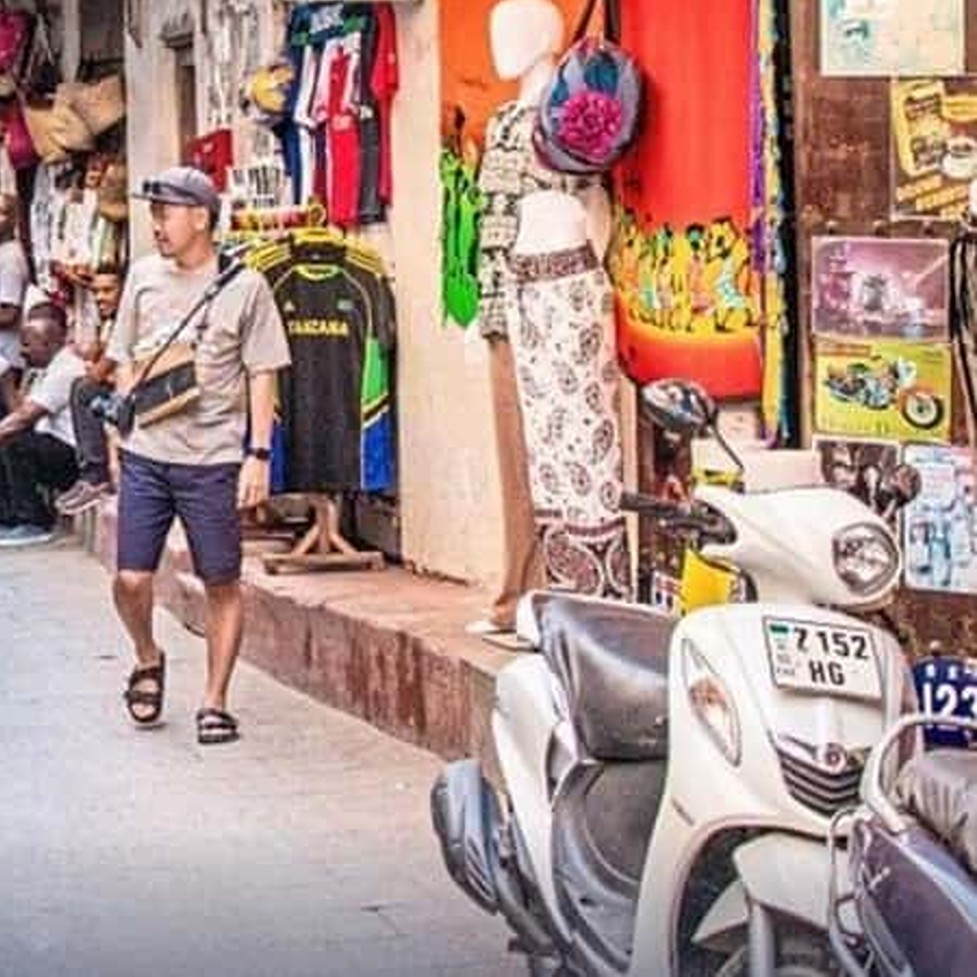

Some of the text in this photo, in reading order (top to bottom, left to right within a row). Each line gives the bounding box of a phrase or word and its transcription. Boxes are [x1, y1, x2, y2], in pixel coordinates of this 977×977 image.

[794, 626, 809, 653] Z
[818, 631, 869, 661] 152
[808, 660, 845, 686] HG
